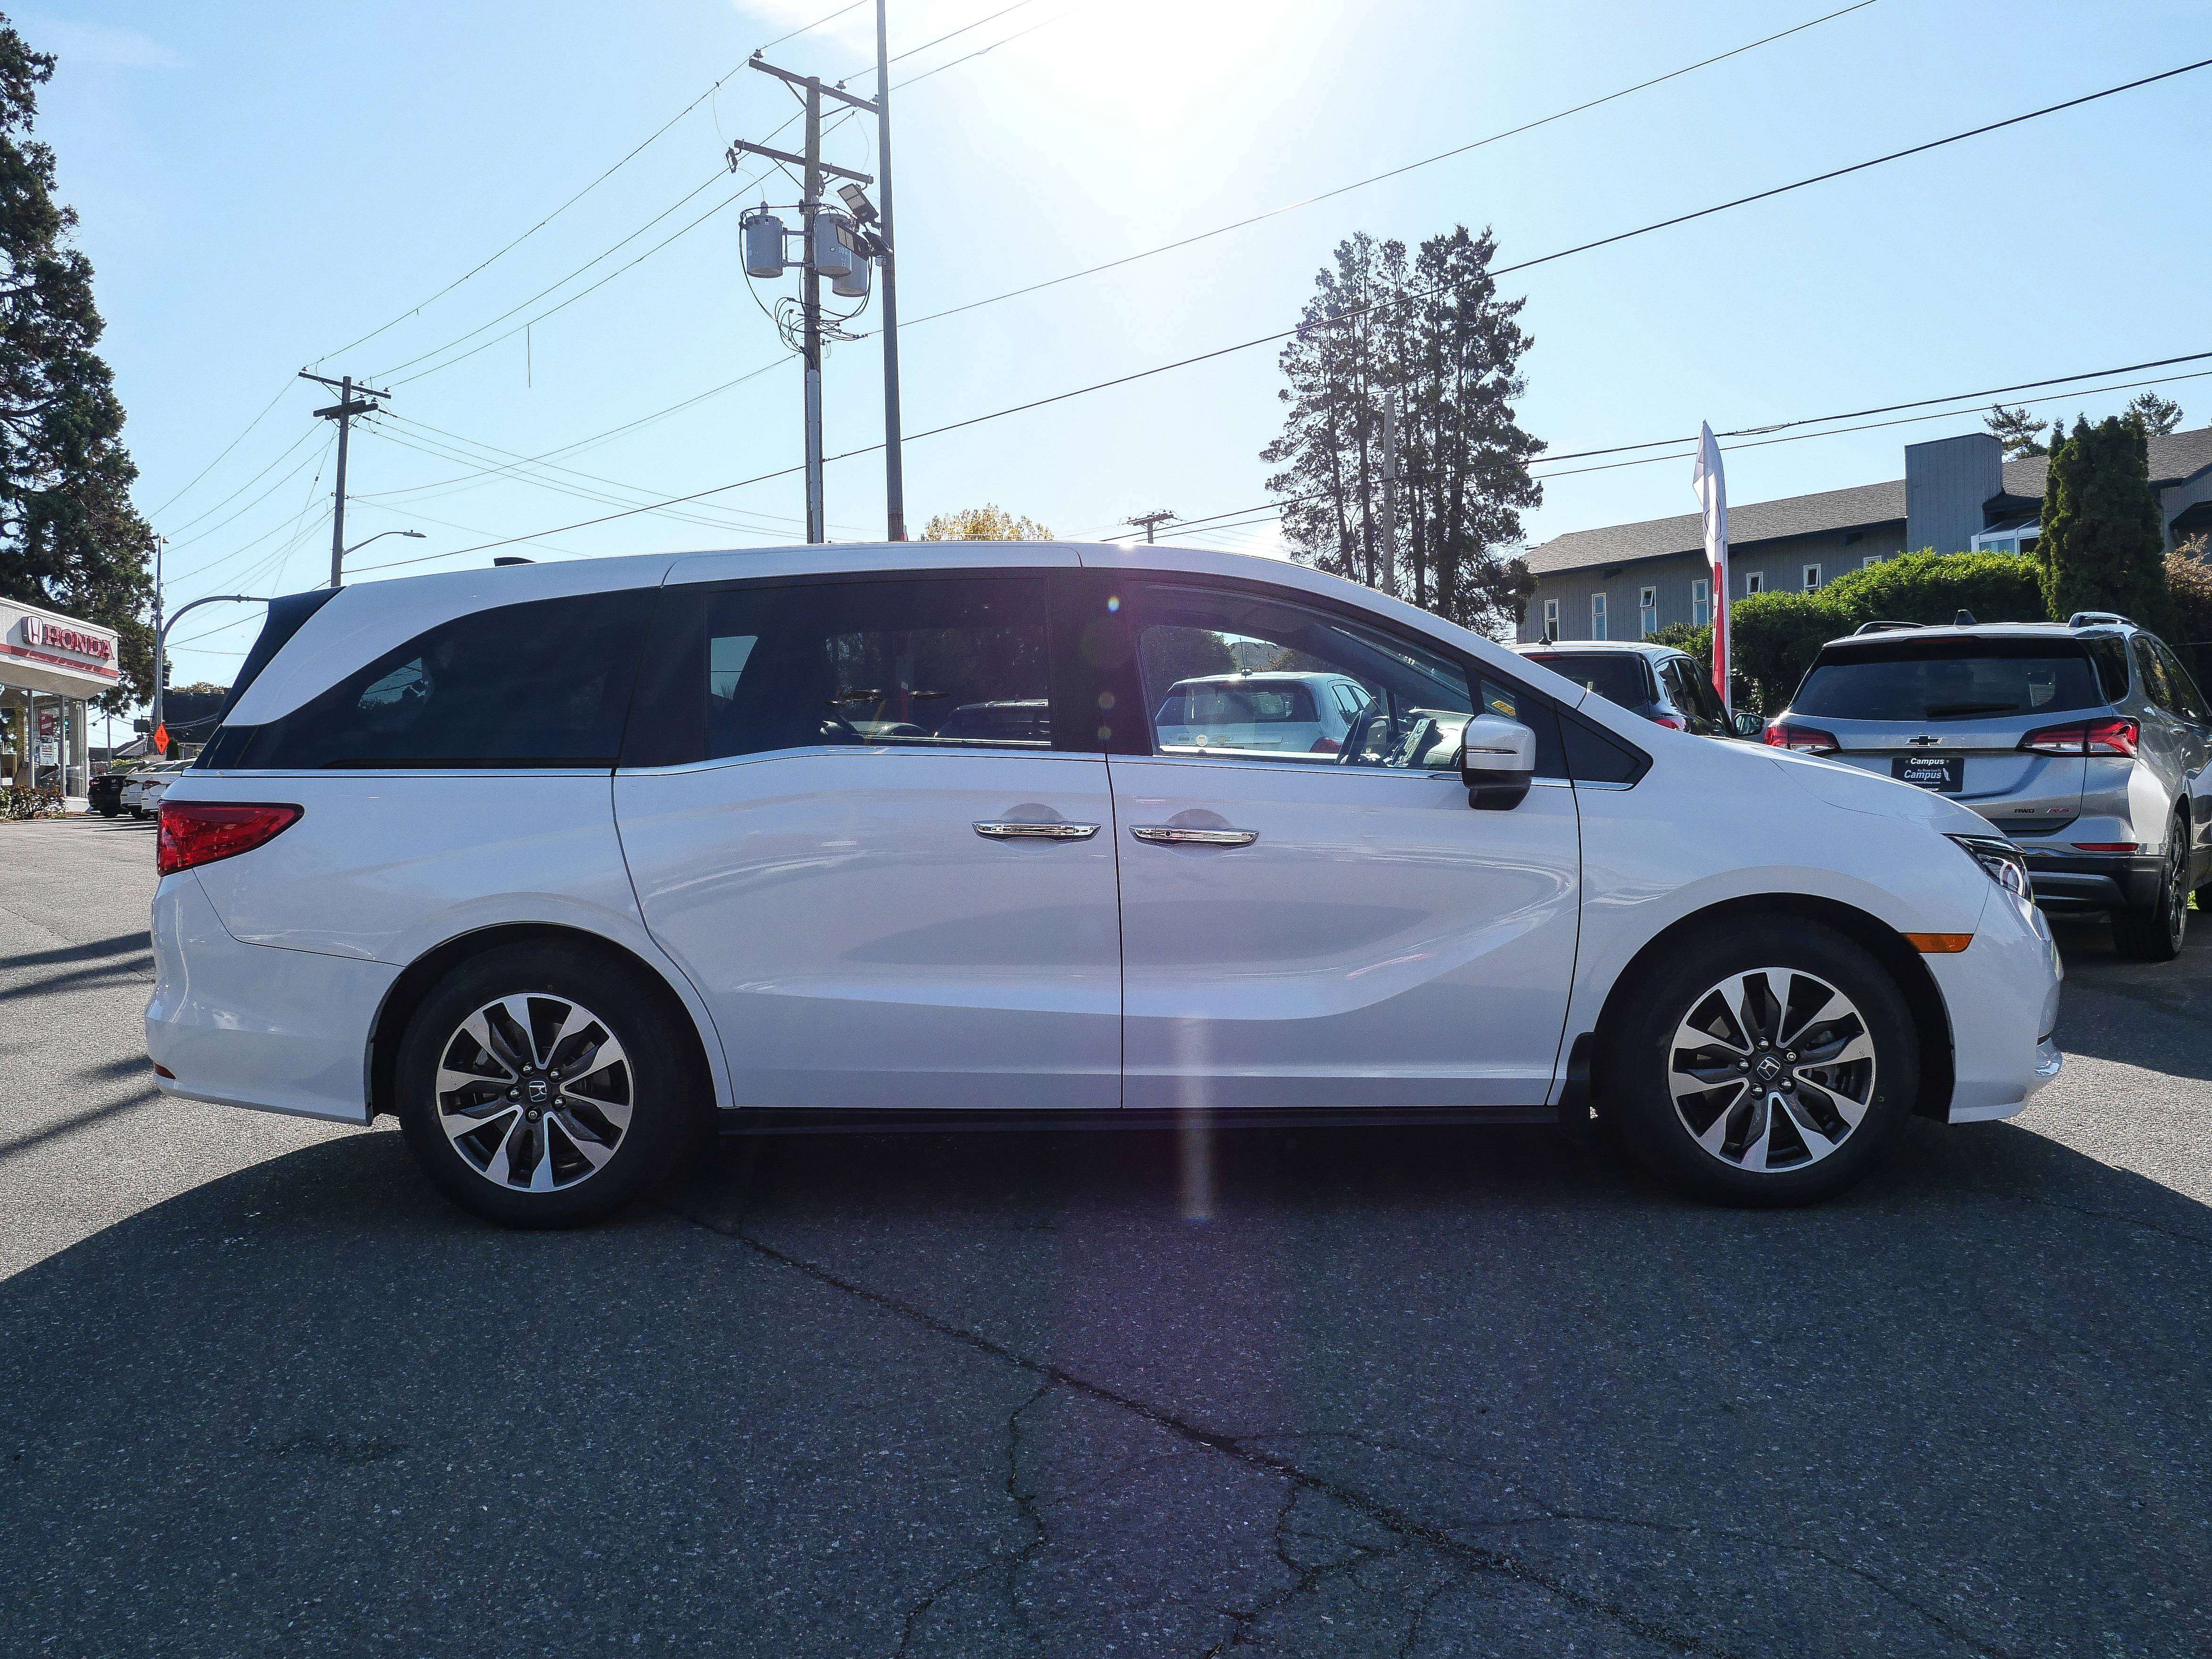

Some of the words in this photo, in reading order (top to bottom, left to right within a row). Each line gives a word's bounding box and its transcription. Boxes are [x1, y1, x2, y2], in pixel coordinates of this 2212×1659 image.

[45, 624, 115, 660] HONDA
[1910, 758, 1944, 766] Campus
[1904, 770, 1942, 780] Campus
